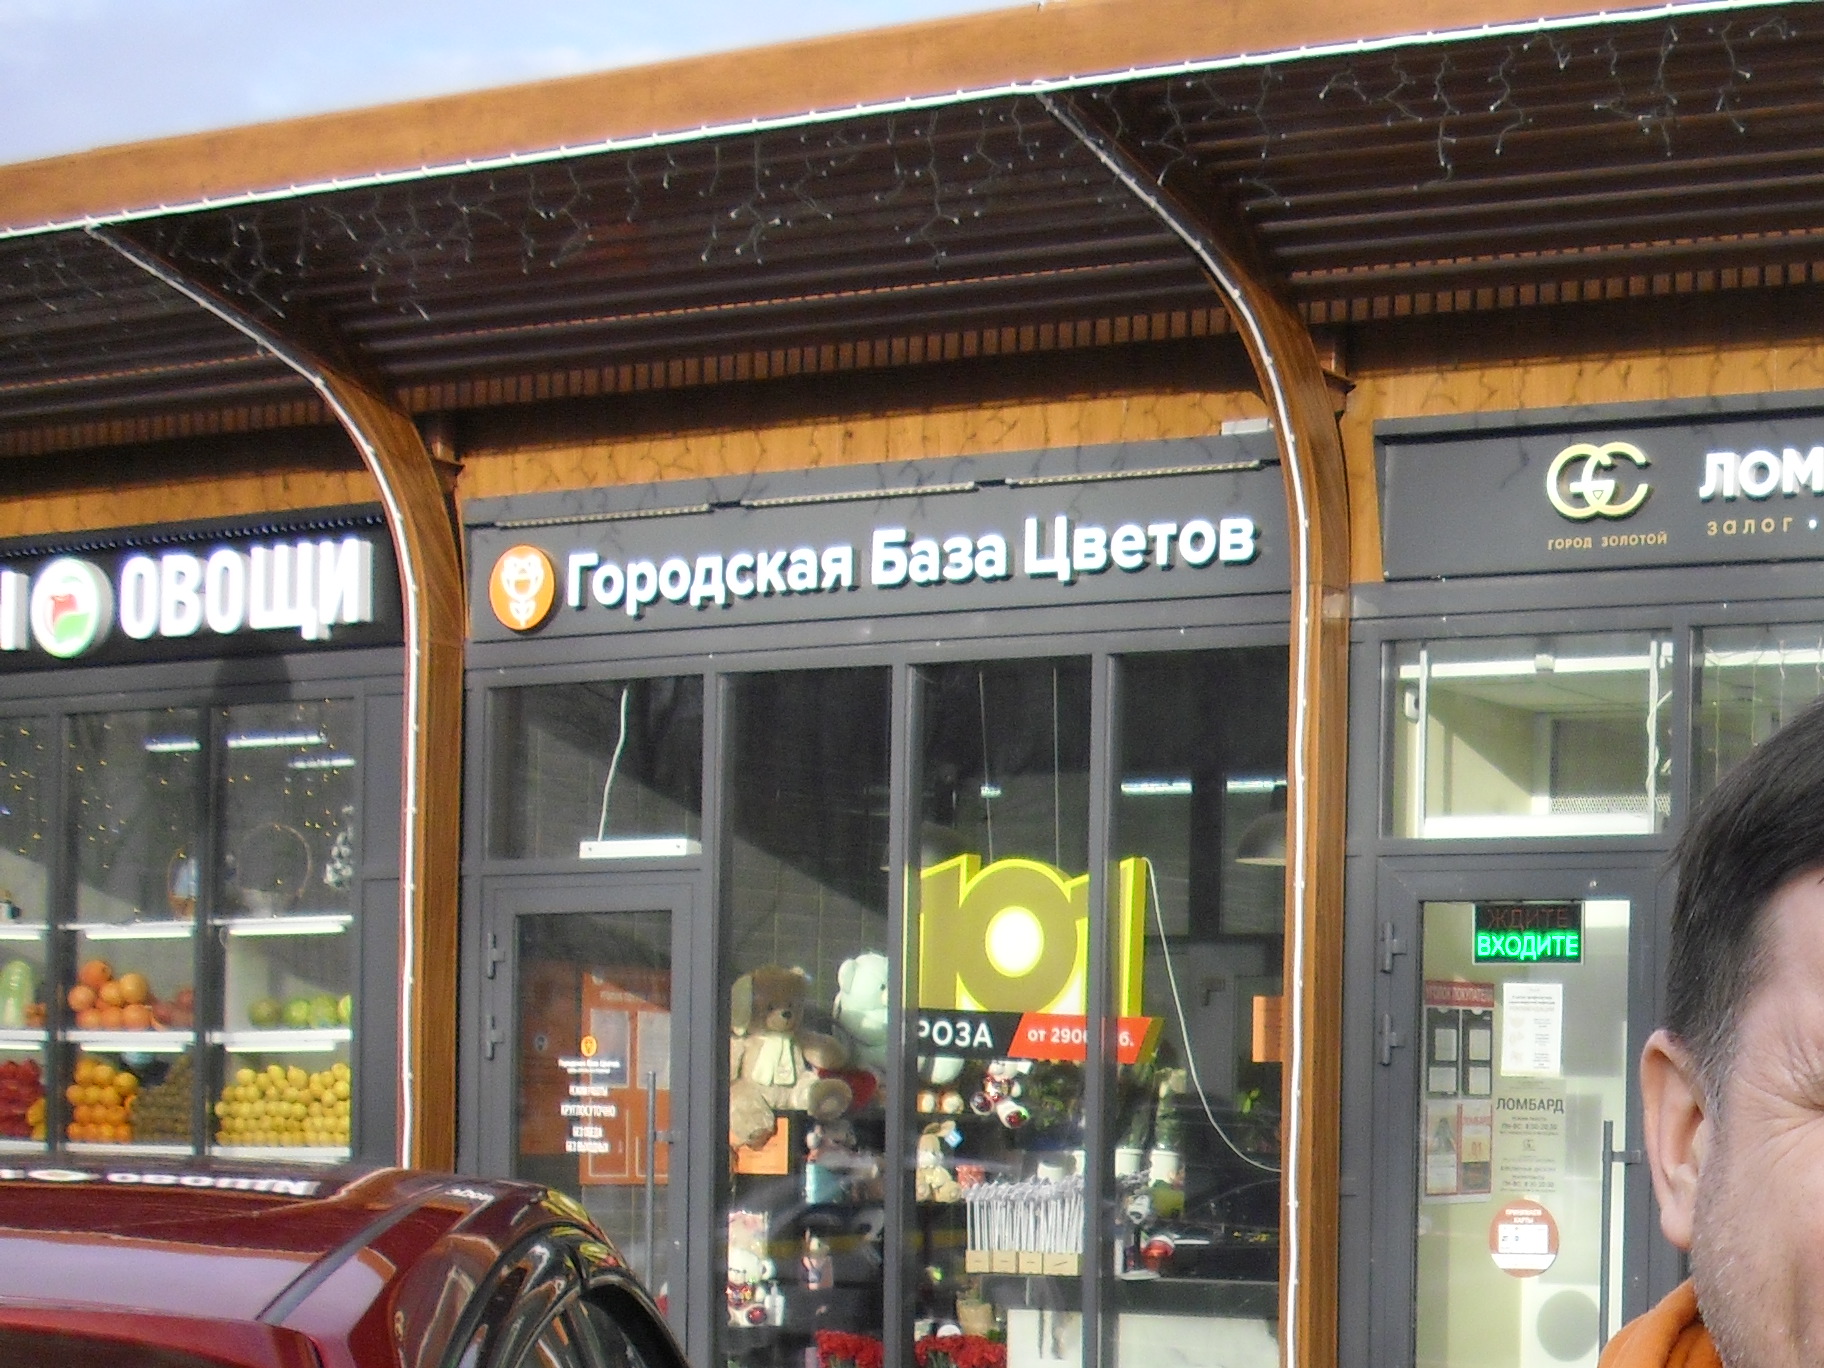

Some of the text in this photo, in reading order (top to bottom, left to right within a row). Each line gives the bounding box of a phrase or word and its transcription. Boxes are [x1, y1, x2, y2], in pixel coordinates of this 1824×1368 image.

[1706, 516, 1793, 536] залог
[1547, 531, 1668, 551] ГОРОД ЗОЛОТОЙ
[567, 514, 1259, 617] Городская База Цветов
[119, 537, 373, 641] ОВОЩИ
[1488, 907, 1568, 930] ЖДИТЕ
[1476, 934, 1580, 961] ВХОДИТЕ
[1027, 1030, 1047, 1043] от
[1496, 1097, 1565, 1114] ЛОМБАРД
